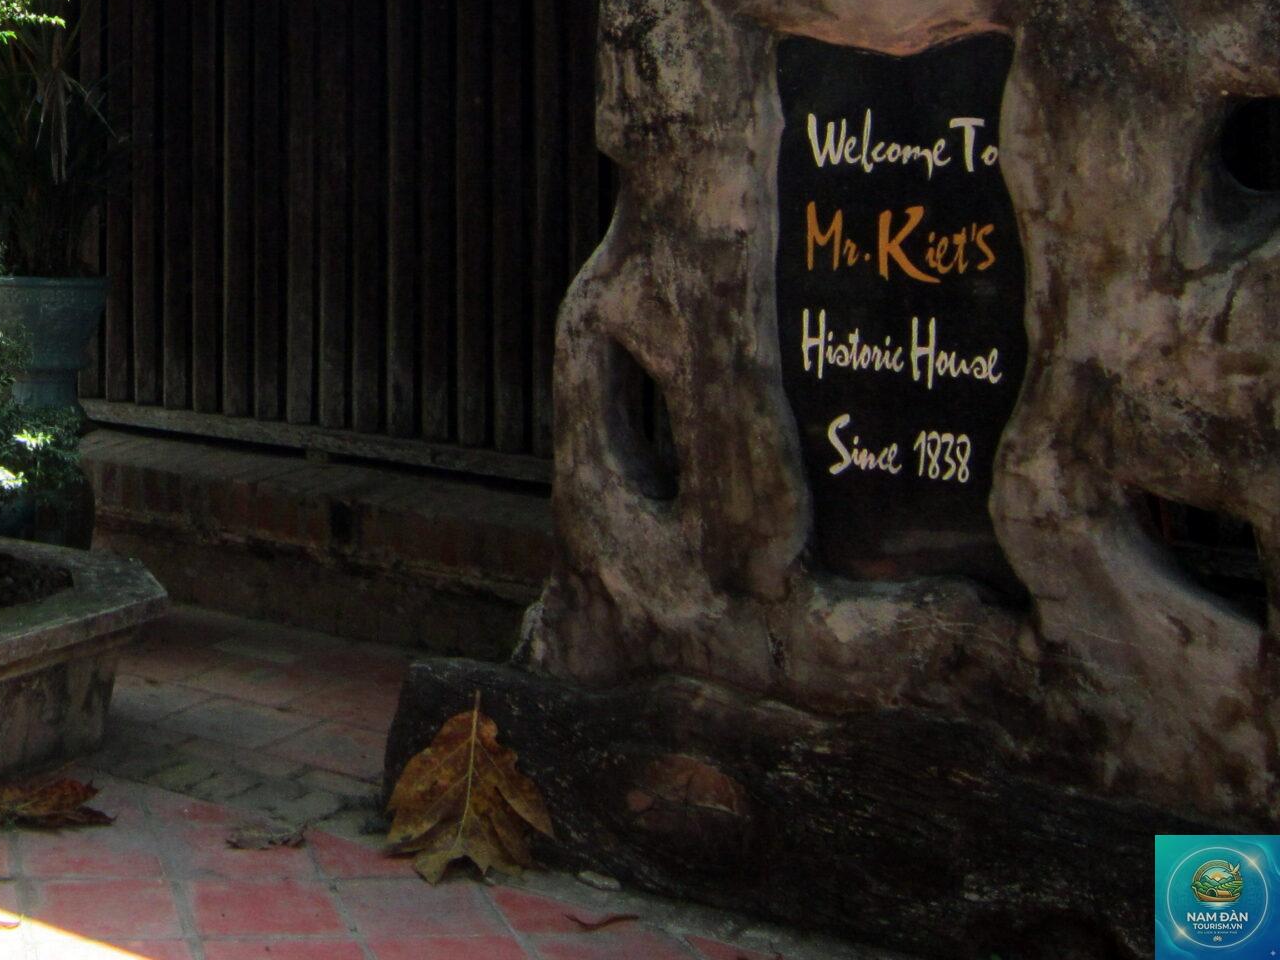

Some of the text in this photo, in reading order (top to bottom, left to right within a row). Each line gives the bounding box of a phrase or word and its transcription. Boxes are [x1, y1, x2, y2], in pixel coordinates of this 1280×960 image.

[806, 108, 999, 180] Welcome To
[801, 308, 1002, 391] Historic House
[827, 413, 972, 484] Since 1838
